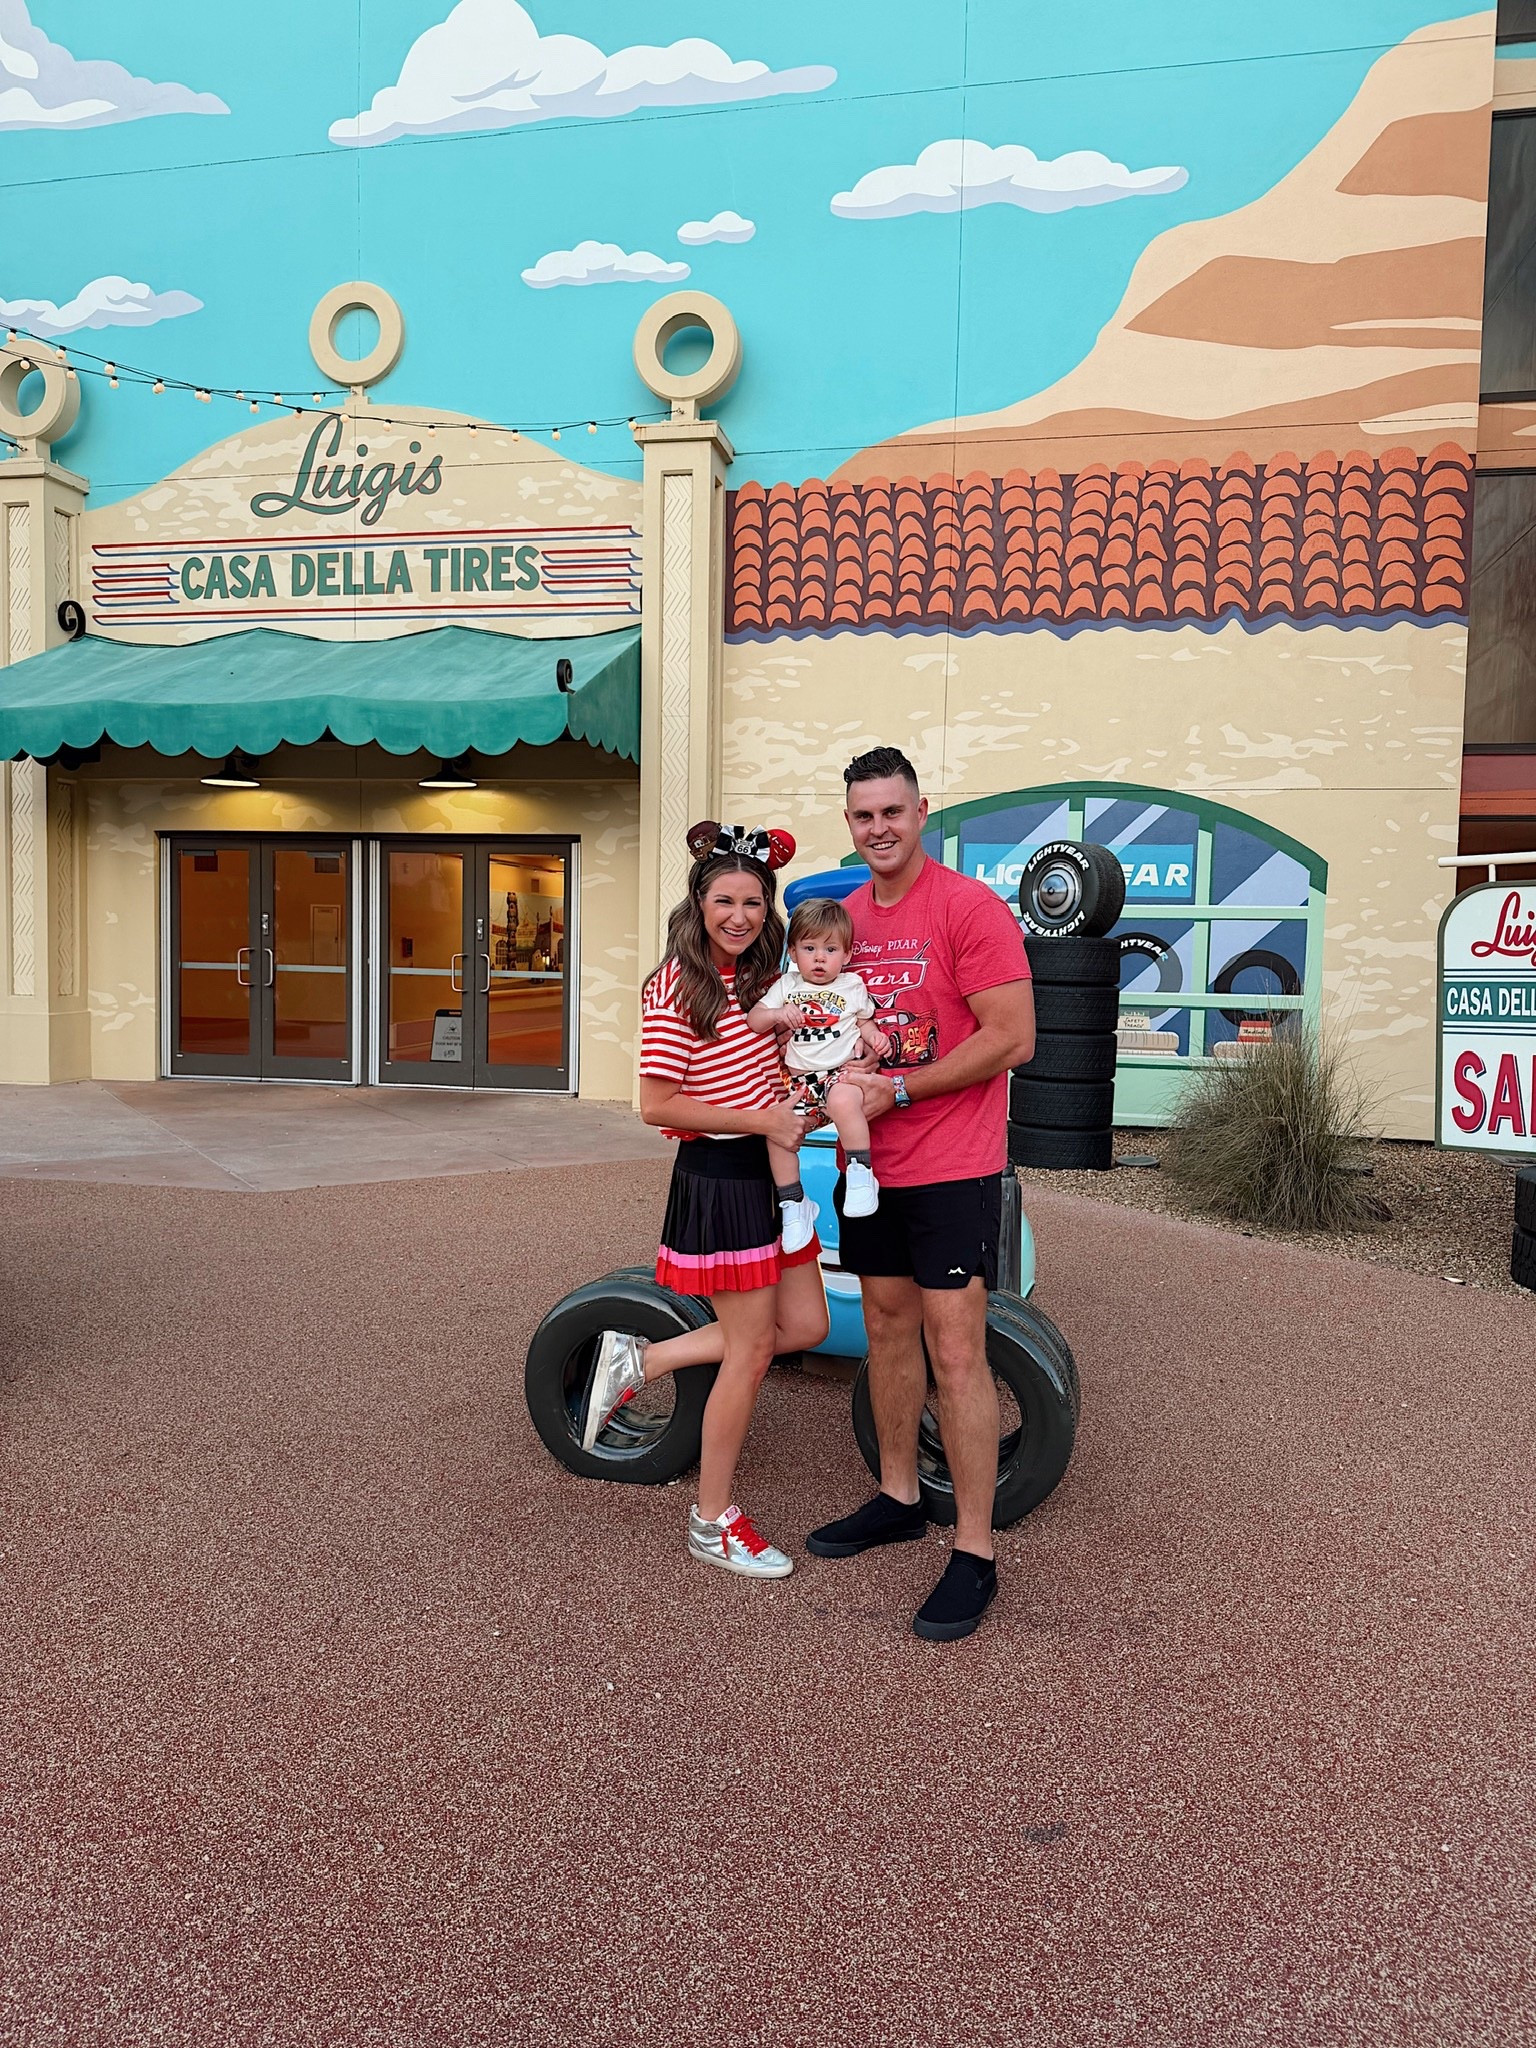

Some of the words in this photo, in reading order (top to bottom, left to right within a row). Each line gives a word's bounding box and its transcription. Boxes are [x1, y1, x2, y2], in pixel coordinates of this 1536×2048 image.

[250, 414, 443, 526] Luigis
[180, 555, 277, 600] CASA
[291, 549, 413, 597] DELLA
[423, 545, 540, 593] TIRES
[737, 844, 749, 853] 66
[1027, 844, 1090, 872] LIGHTYEAR
[975, 863, 1190, 887] LIGEAR
[1023, 910, 1086, 938] LIGHTYEAR
[887, 938, 918, 951] PIXAR
[1446, 987, 1493, 1016] CASA
[908, 1027, 921, 1047] 95
[1451, 1050, 1536, 1136] SA
